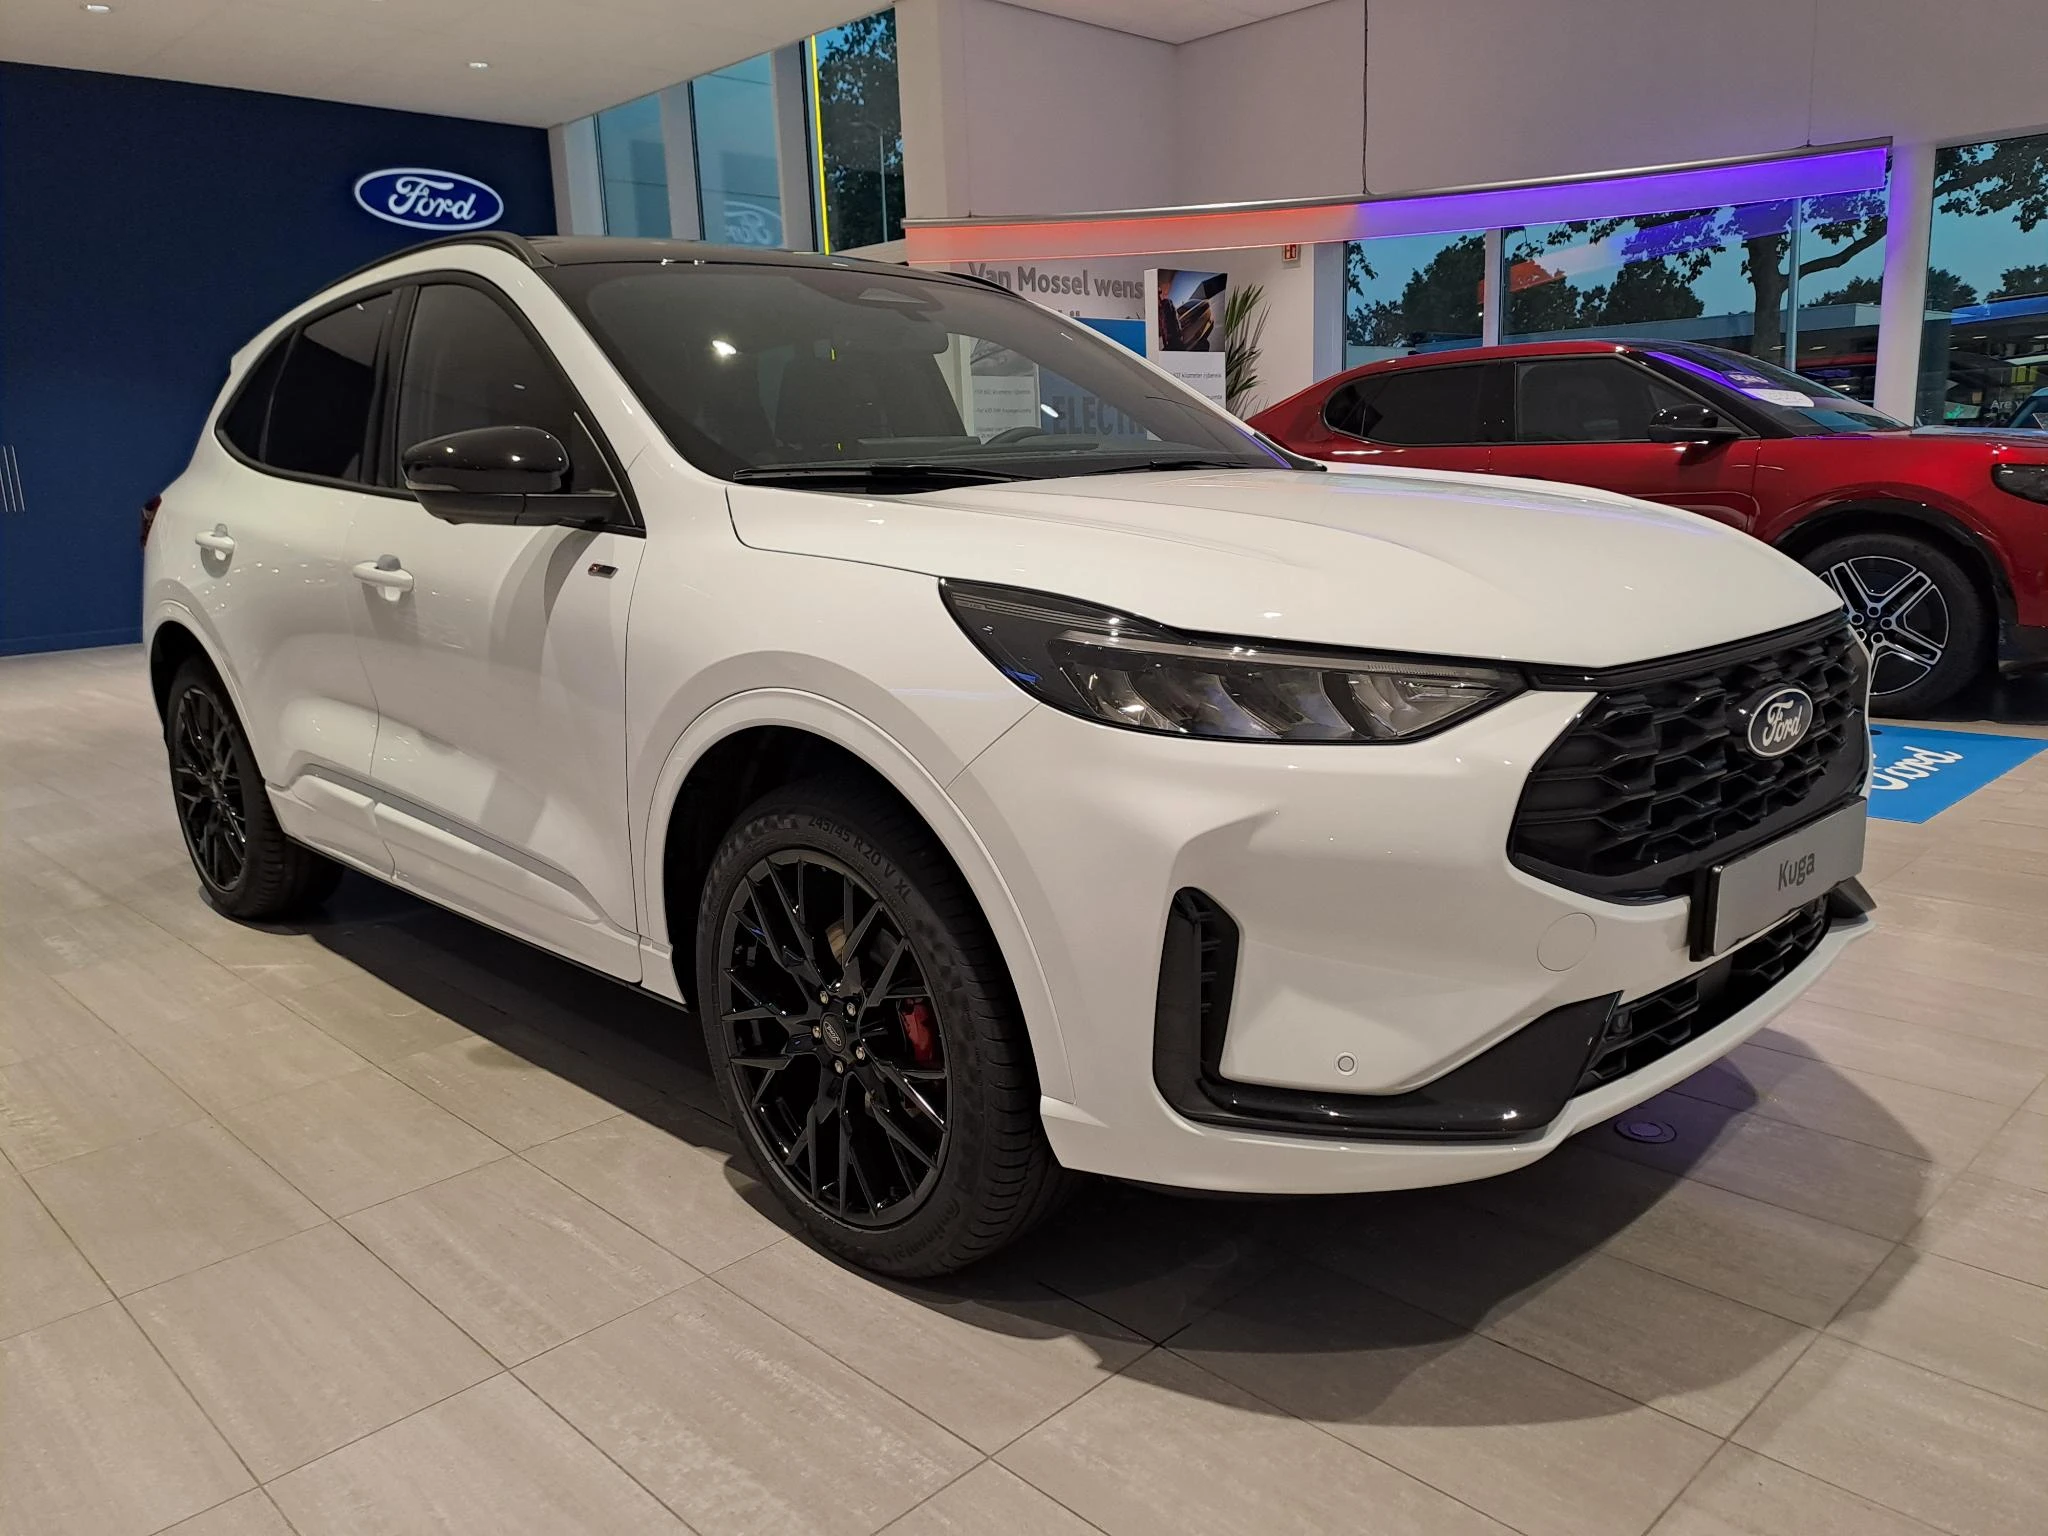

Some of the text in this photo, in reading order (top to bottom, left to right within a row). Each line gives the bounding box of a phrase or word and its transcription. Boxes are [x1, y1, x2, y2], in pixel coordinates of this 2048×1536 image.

[388, 176, 477, 220] Ford
[968, 261, 1012, 290] Van
[1017, 266, 1090, 296] Mossel
[1763, 699, 1803, 747] Ford
[808, 813, 851, 842] 245/45
[884, 863, 896, 878] V
[894, 879, 912, 904] XL
[1777, 852, 1816, 891] Kuga
